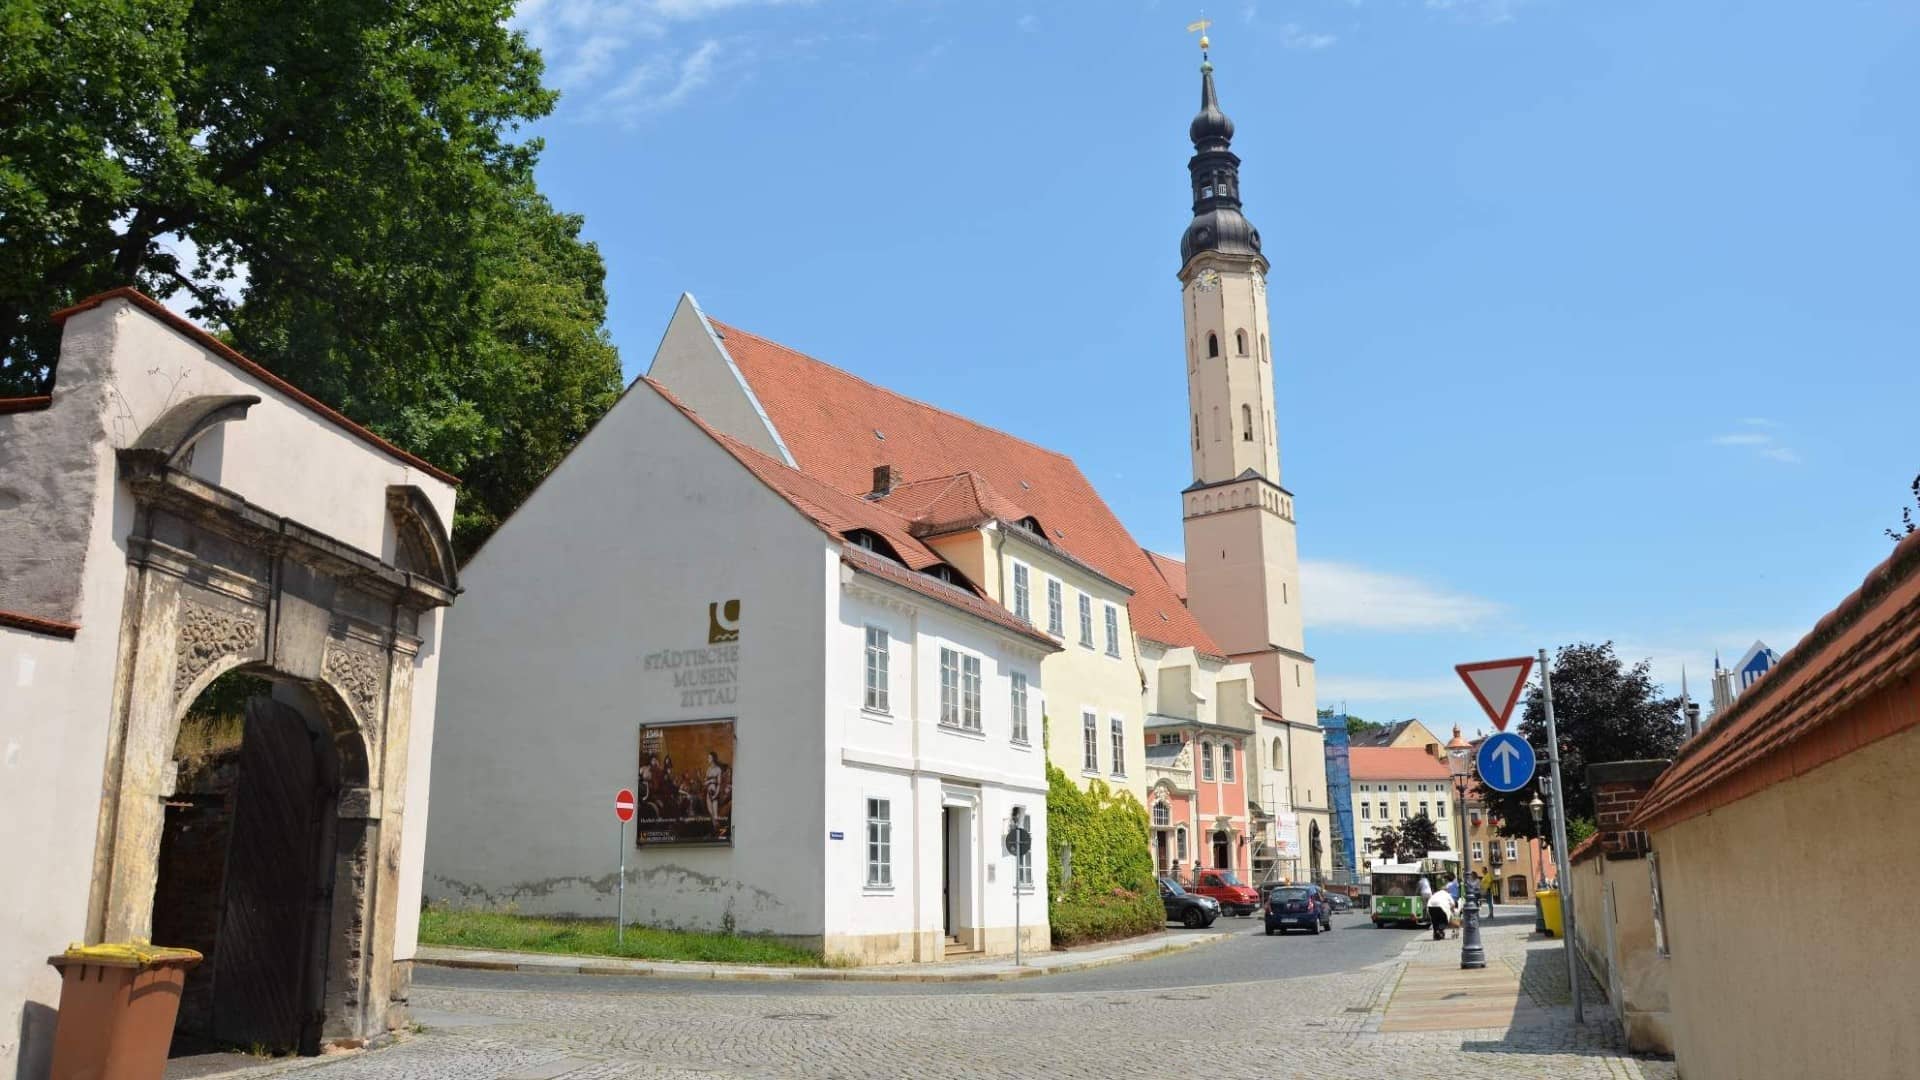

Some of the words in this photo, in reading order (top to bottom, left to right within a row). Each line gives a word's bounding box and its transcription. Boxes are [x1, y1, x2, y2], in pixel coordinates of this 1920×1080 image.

[644, 646, 739, 671] STÄDTISCHE
[673, 665, 738, 688] MUSEEN
[681, 687, 737, 707] ZITTAU
